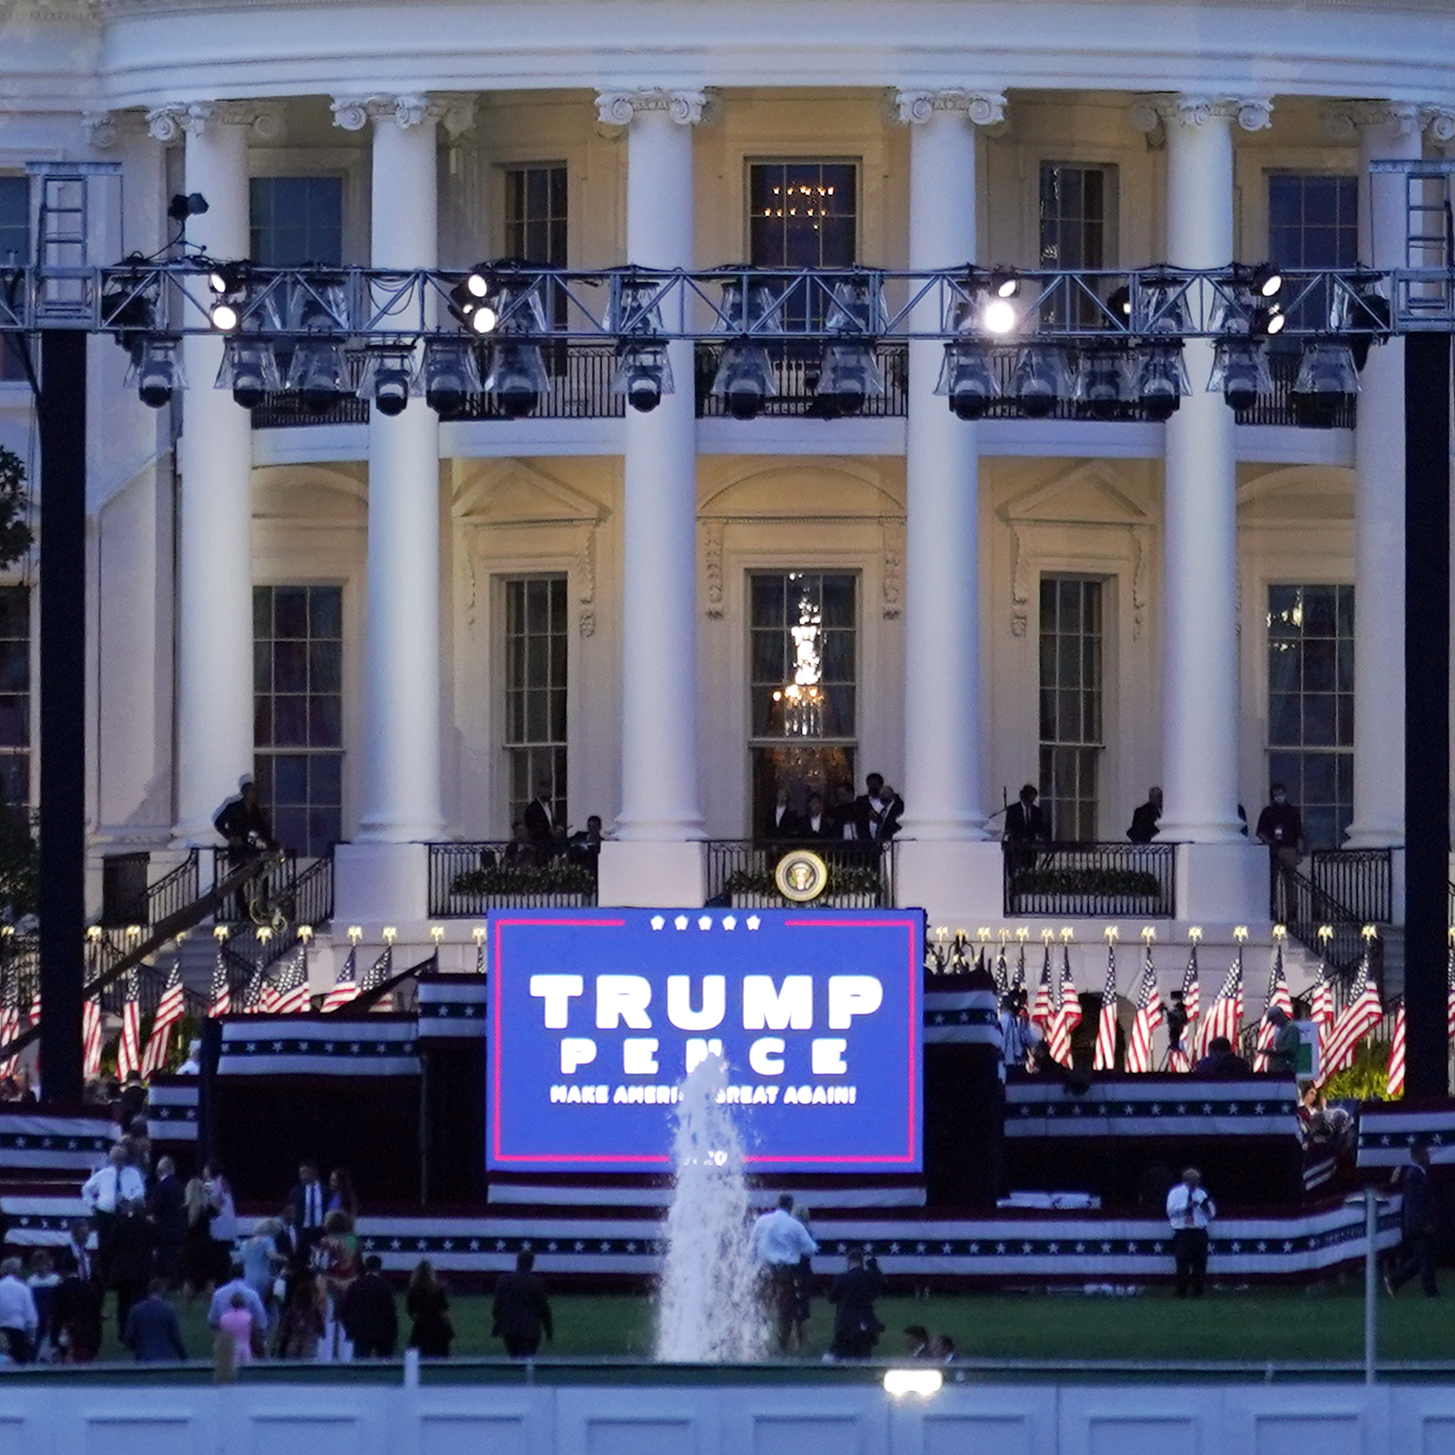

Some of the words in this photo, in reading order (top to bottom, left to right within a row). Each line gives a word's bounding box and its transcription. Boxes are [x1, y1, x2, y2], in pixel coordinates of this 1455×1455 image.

[529, 973, 883, 1031] TRUMP
[560, 1037, 848, 1076] PENCE
[550, 1085, 609, 1104] MAKE
[613, 1085, 683, 1104] AMERI
[783, 1085, 857, 1105] AGAIN!
